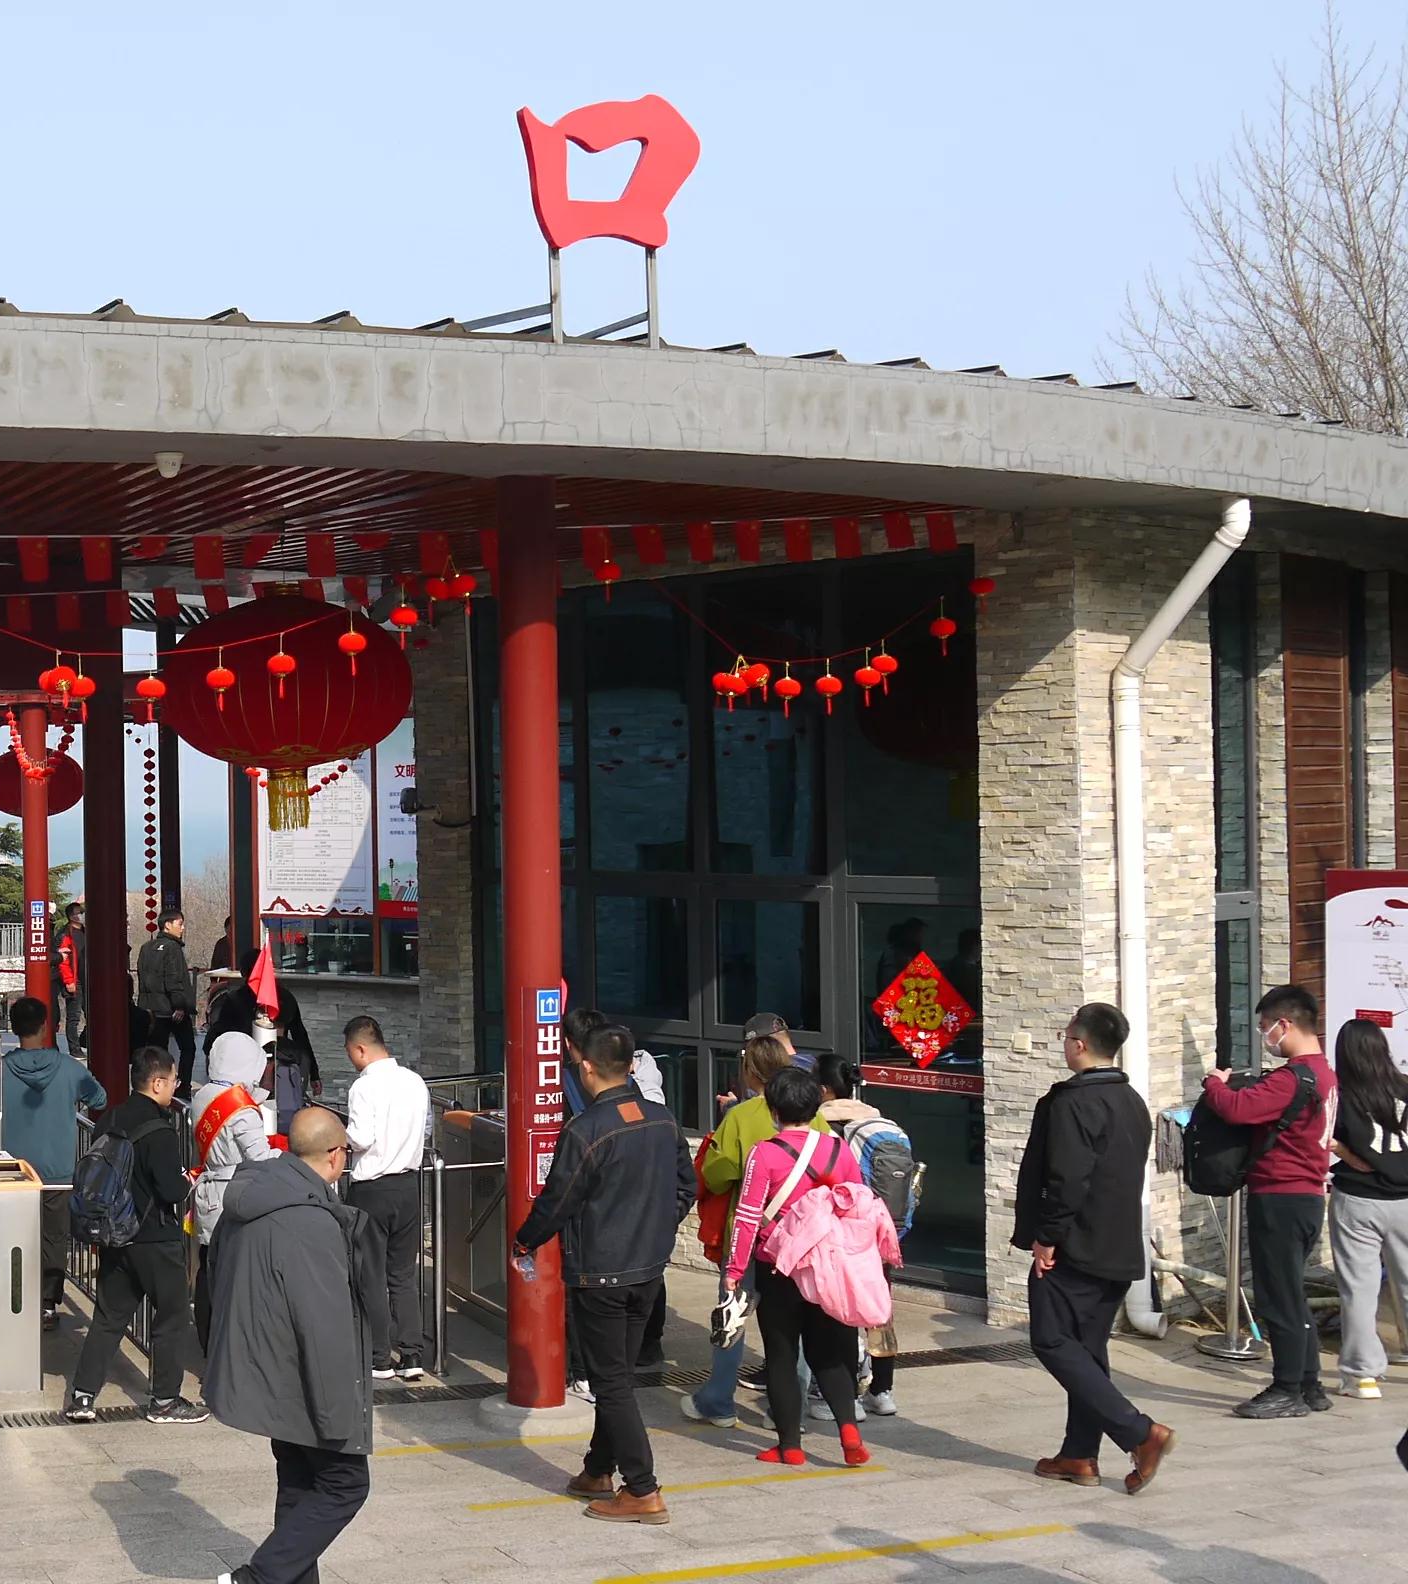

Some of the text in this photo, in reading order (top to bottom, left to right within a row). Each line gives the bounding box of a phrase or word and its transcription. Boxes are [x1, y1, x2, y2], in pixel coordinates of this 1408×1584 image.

[31, 916, 45, 945] 出口
[896, 976, 945, 1030] 福
[536, 1025, 561, 1087] 出口
[535, 1091, 564, 1106] EXIT
